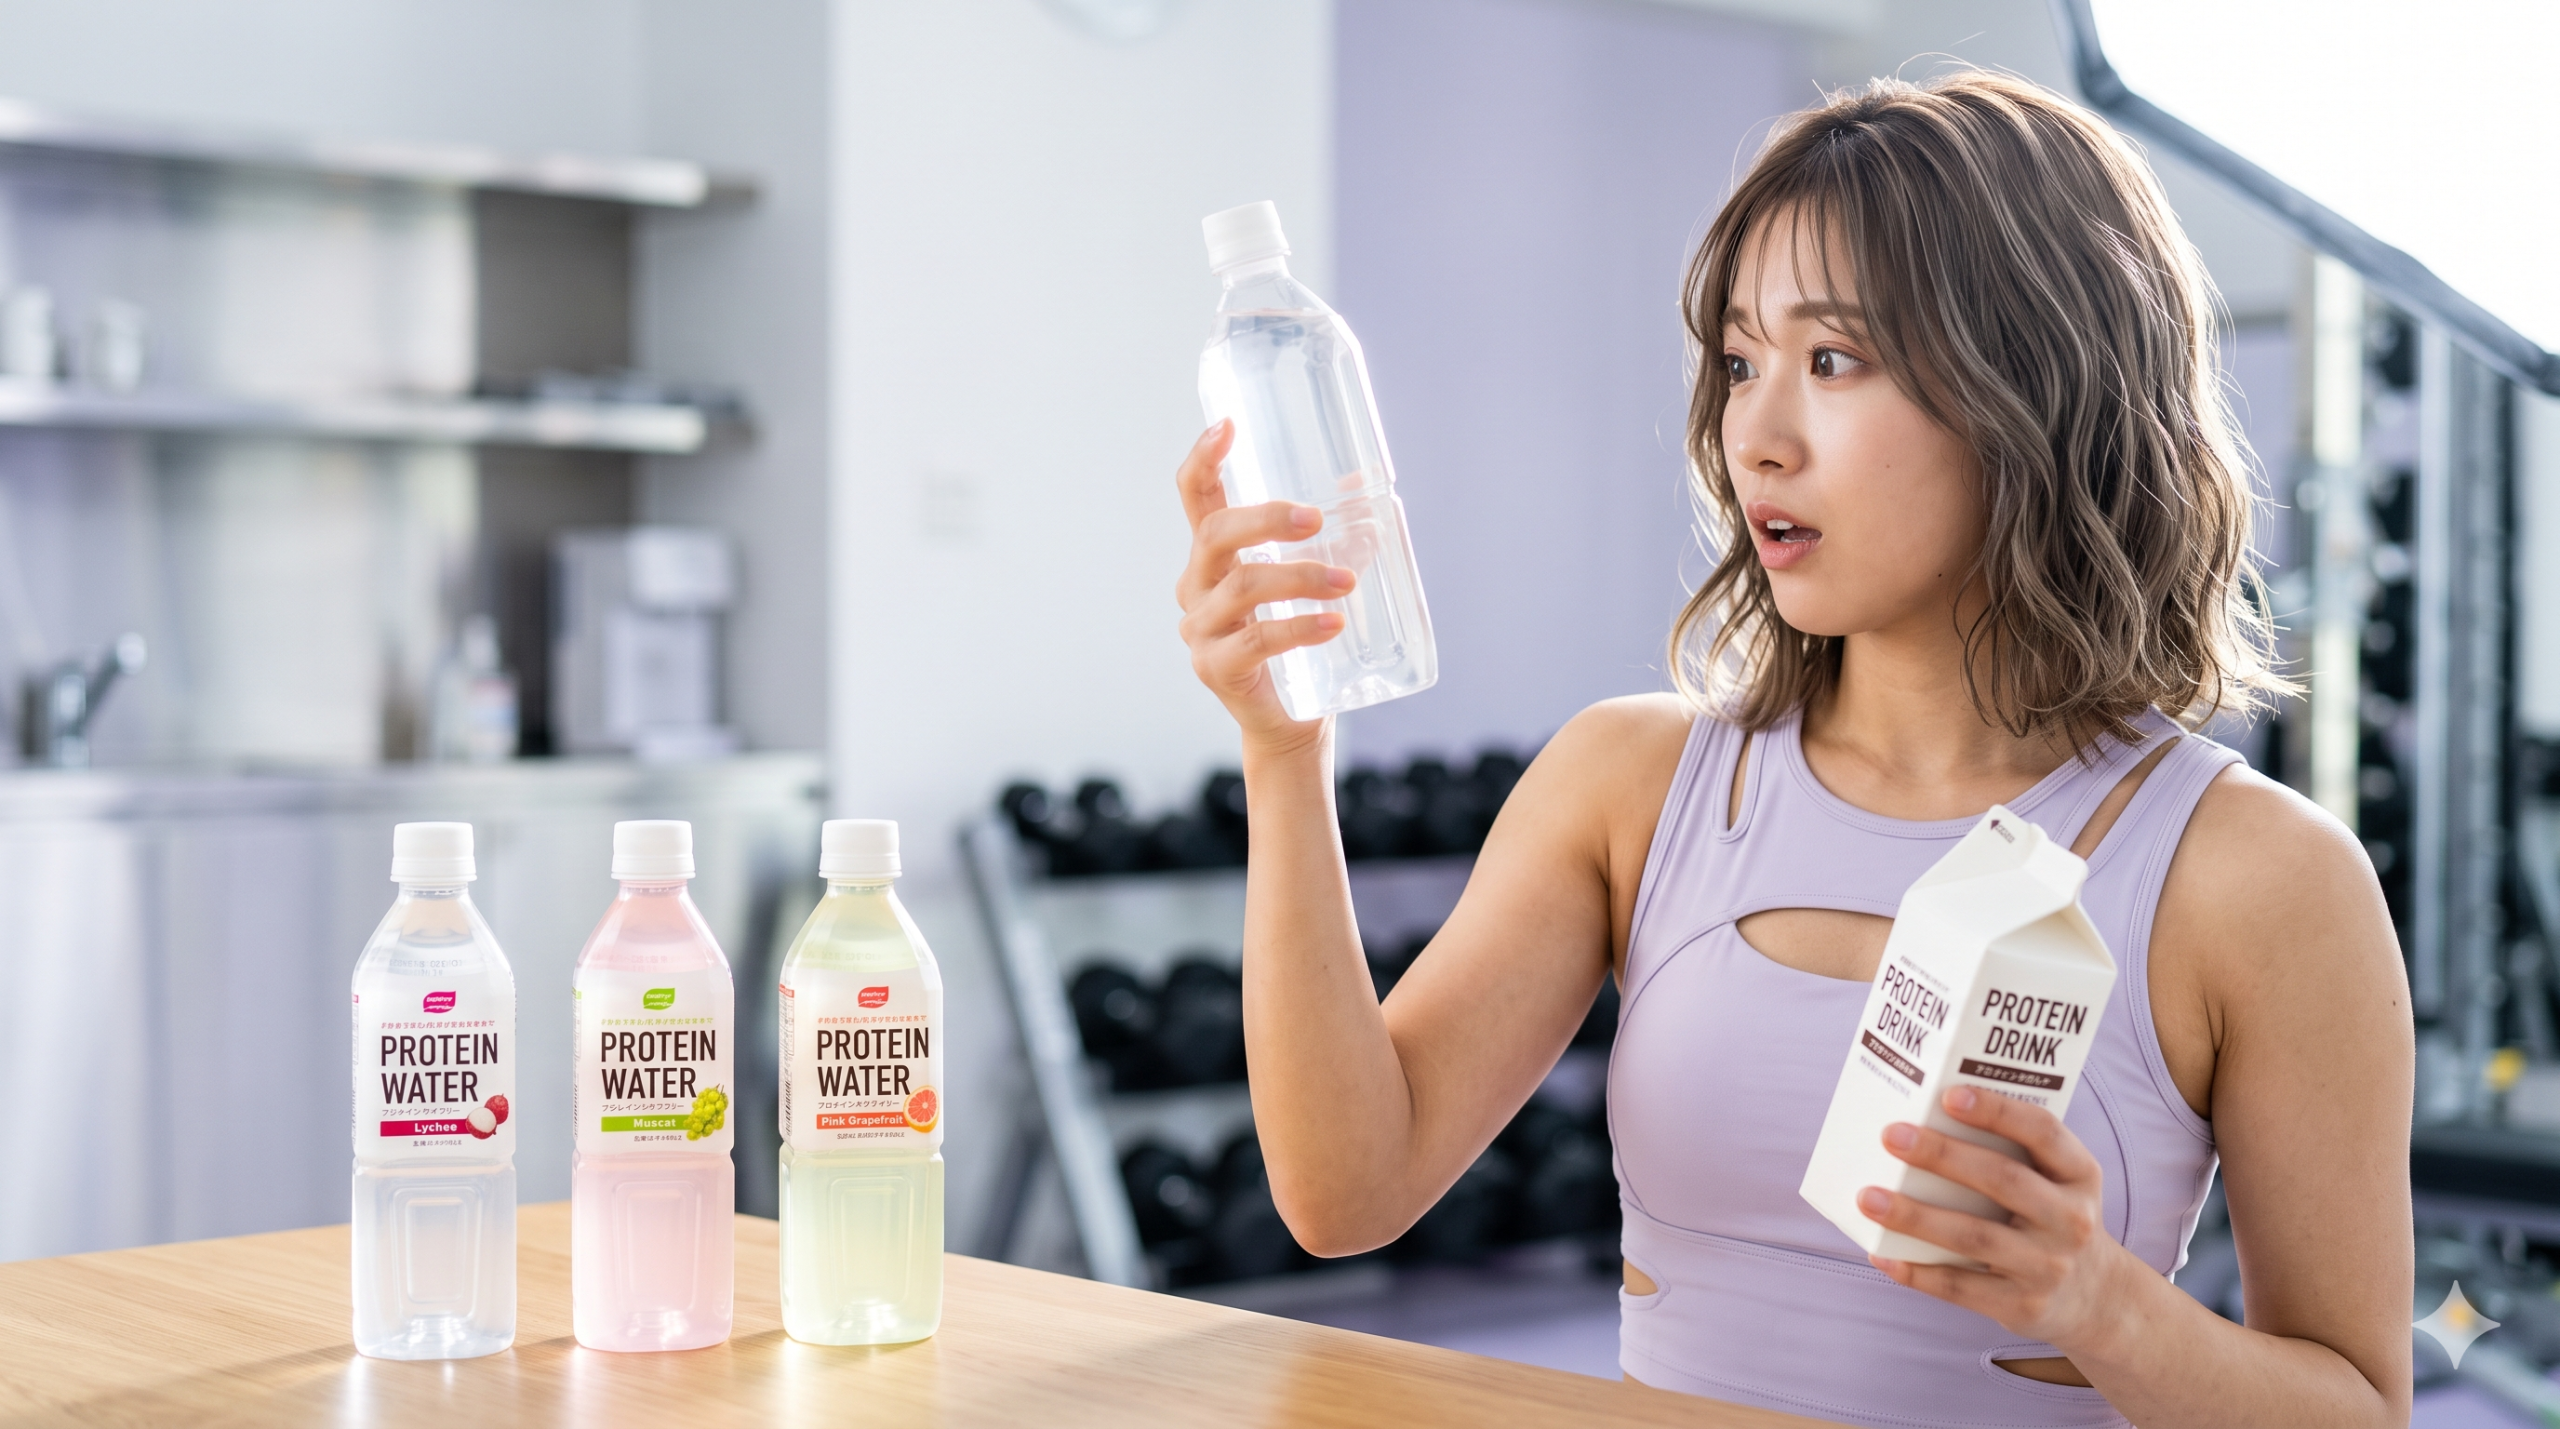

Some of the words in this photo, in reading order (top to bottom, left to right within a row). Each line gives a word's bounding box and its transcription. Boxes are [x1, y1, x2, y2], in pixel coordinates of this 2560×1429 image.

[1880, 963, 1950, 1030] PROTEIN
[1981, 988, 2088, 1035] PROTEIN
[601, 1030, 716, 1063] PROTEIN
[817, 1027, 929, 1061] PROTEIN
[1877, 1002, 1929, 1058] DRINK
[1983, 1026, 2063, 1067] DRINK
[381, 1033, 498, 1067] PROTEIN
[381, 1071, 479, 1105] WATER
[601, 1067, 697, 1100] WATER
[817, 1064, 911, 1097] WATER
[414, 1122, 458, 1134] Lychee
[633, 1118, 677, 1128] Muscat
[821, 1115, 845, 1126] Pink
